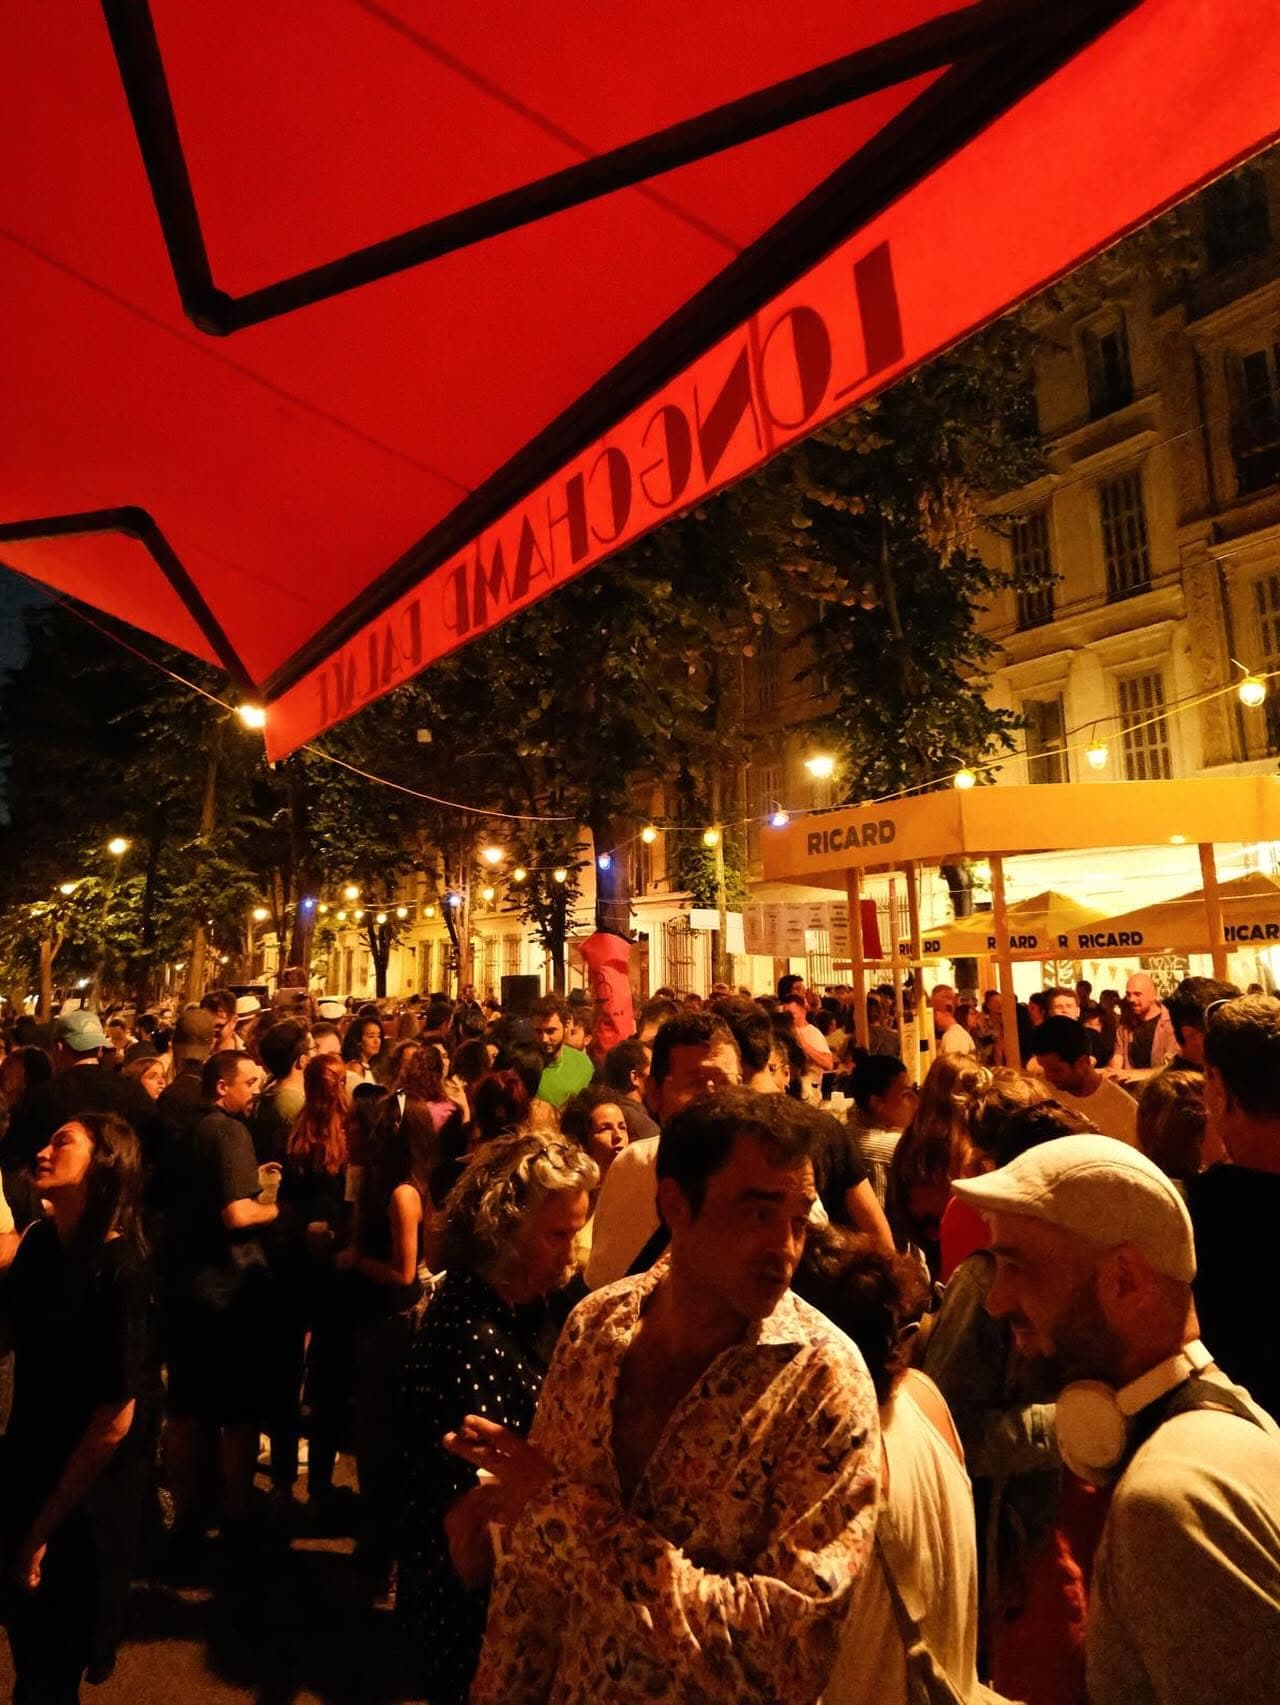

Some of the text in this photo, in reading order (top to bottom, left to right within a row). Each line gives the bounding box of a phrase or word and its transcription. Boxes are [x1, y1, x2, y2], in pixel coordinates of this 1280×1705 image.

[807, 820, 896, 855] RICARD
[987, 935, 1037, 949] RARD
[1078, 931, 1143, 948] RICARD
